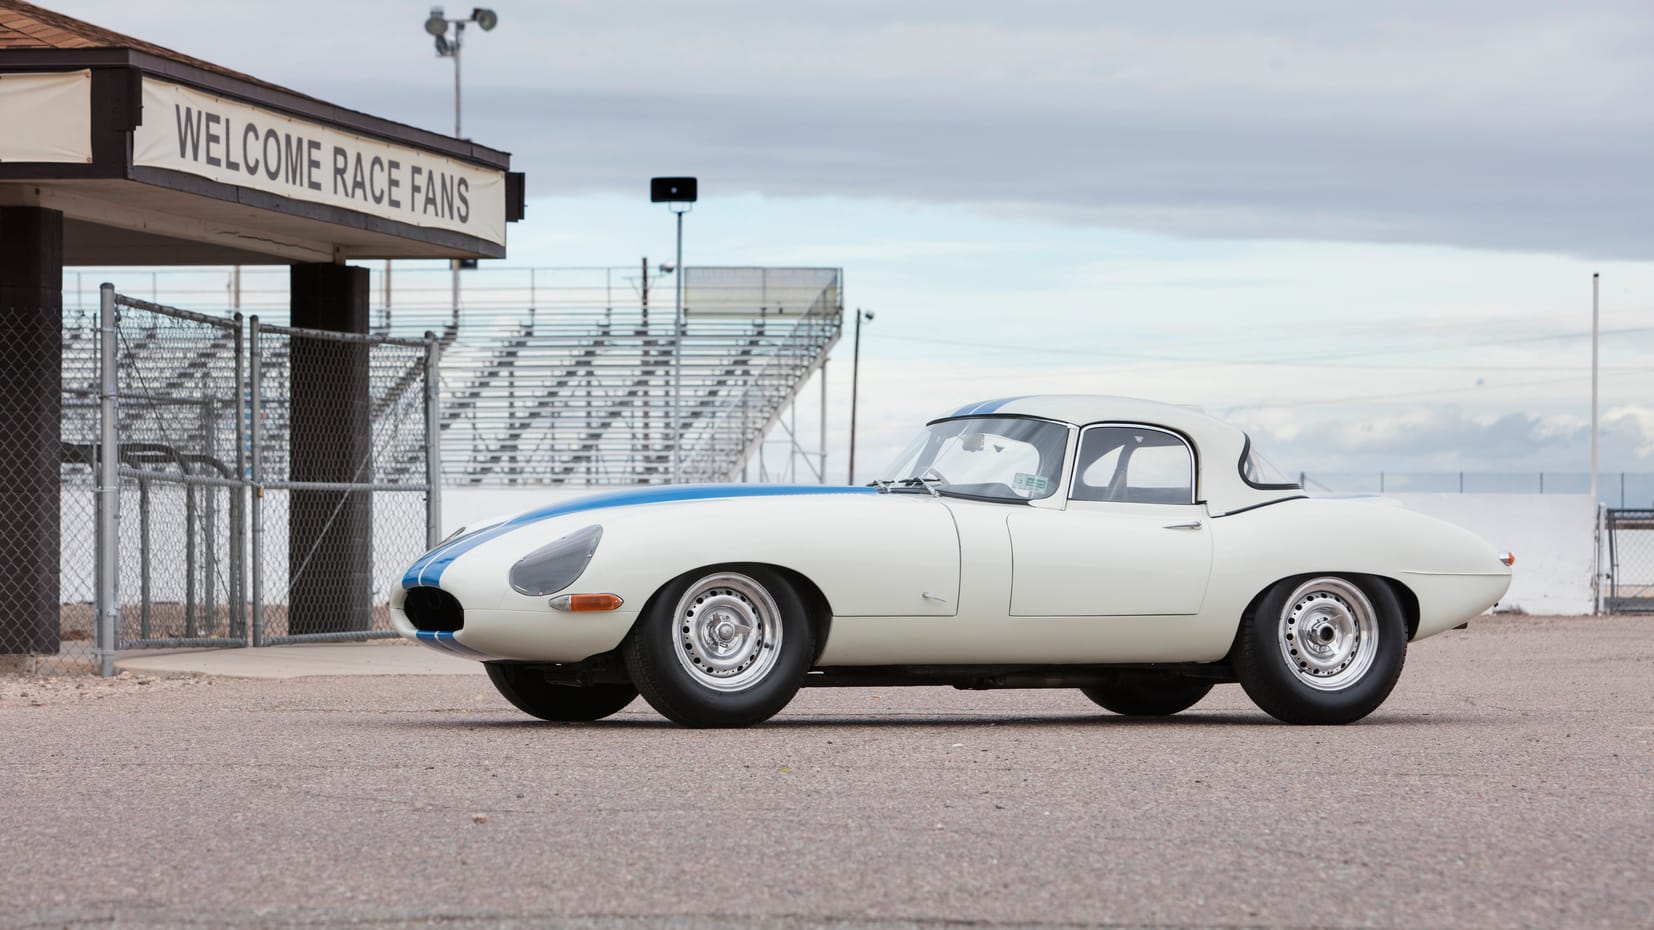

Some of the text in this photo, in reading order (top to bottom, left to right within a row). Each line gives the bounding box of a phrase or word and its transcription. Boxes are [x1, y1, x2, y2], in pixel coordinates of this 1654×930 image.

[175, 103, 470, 224] WELCOME RACE FANS
